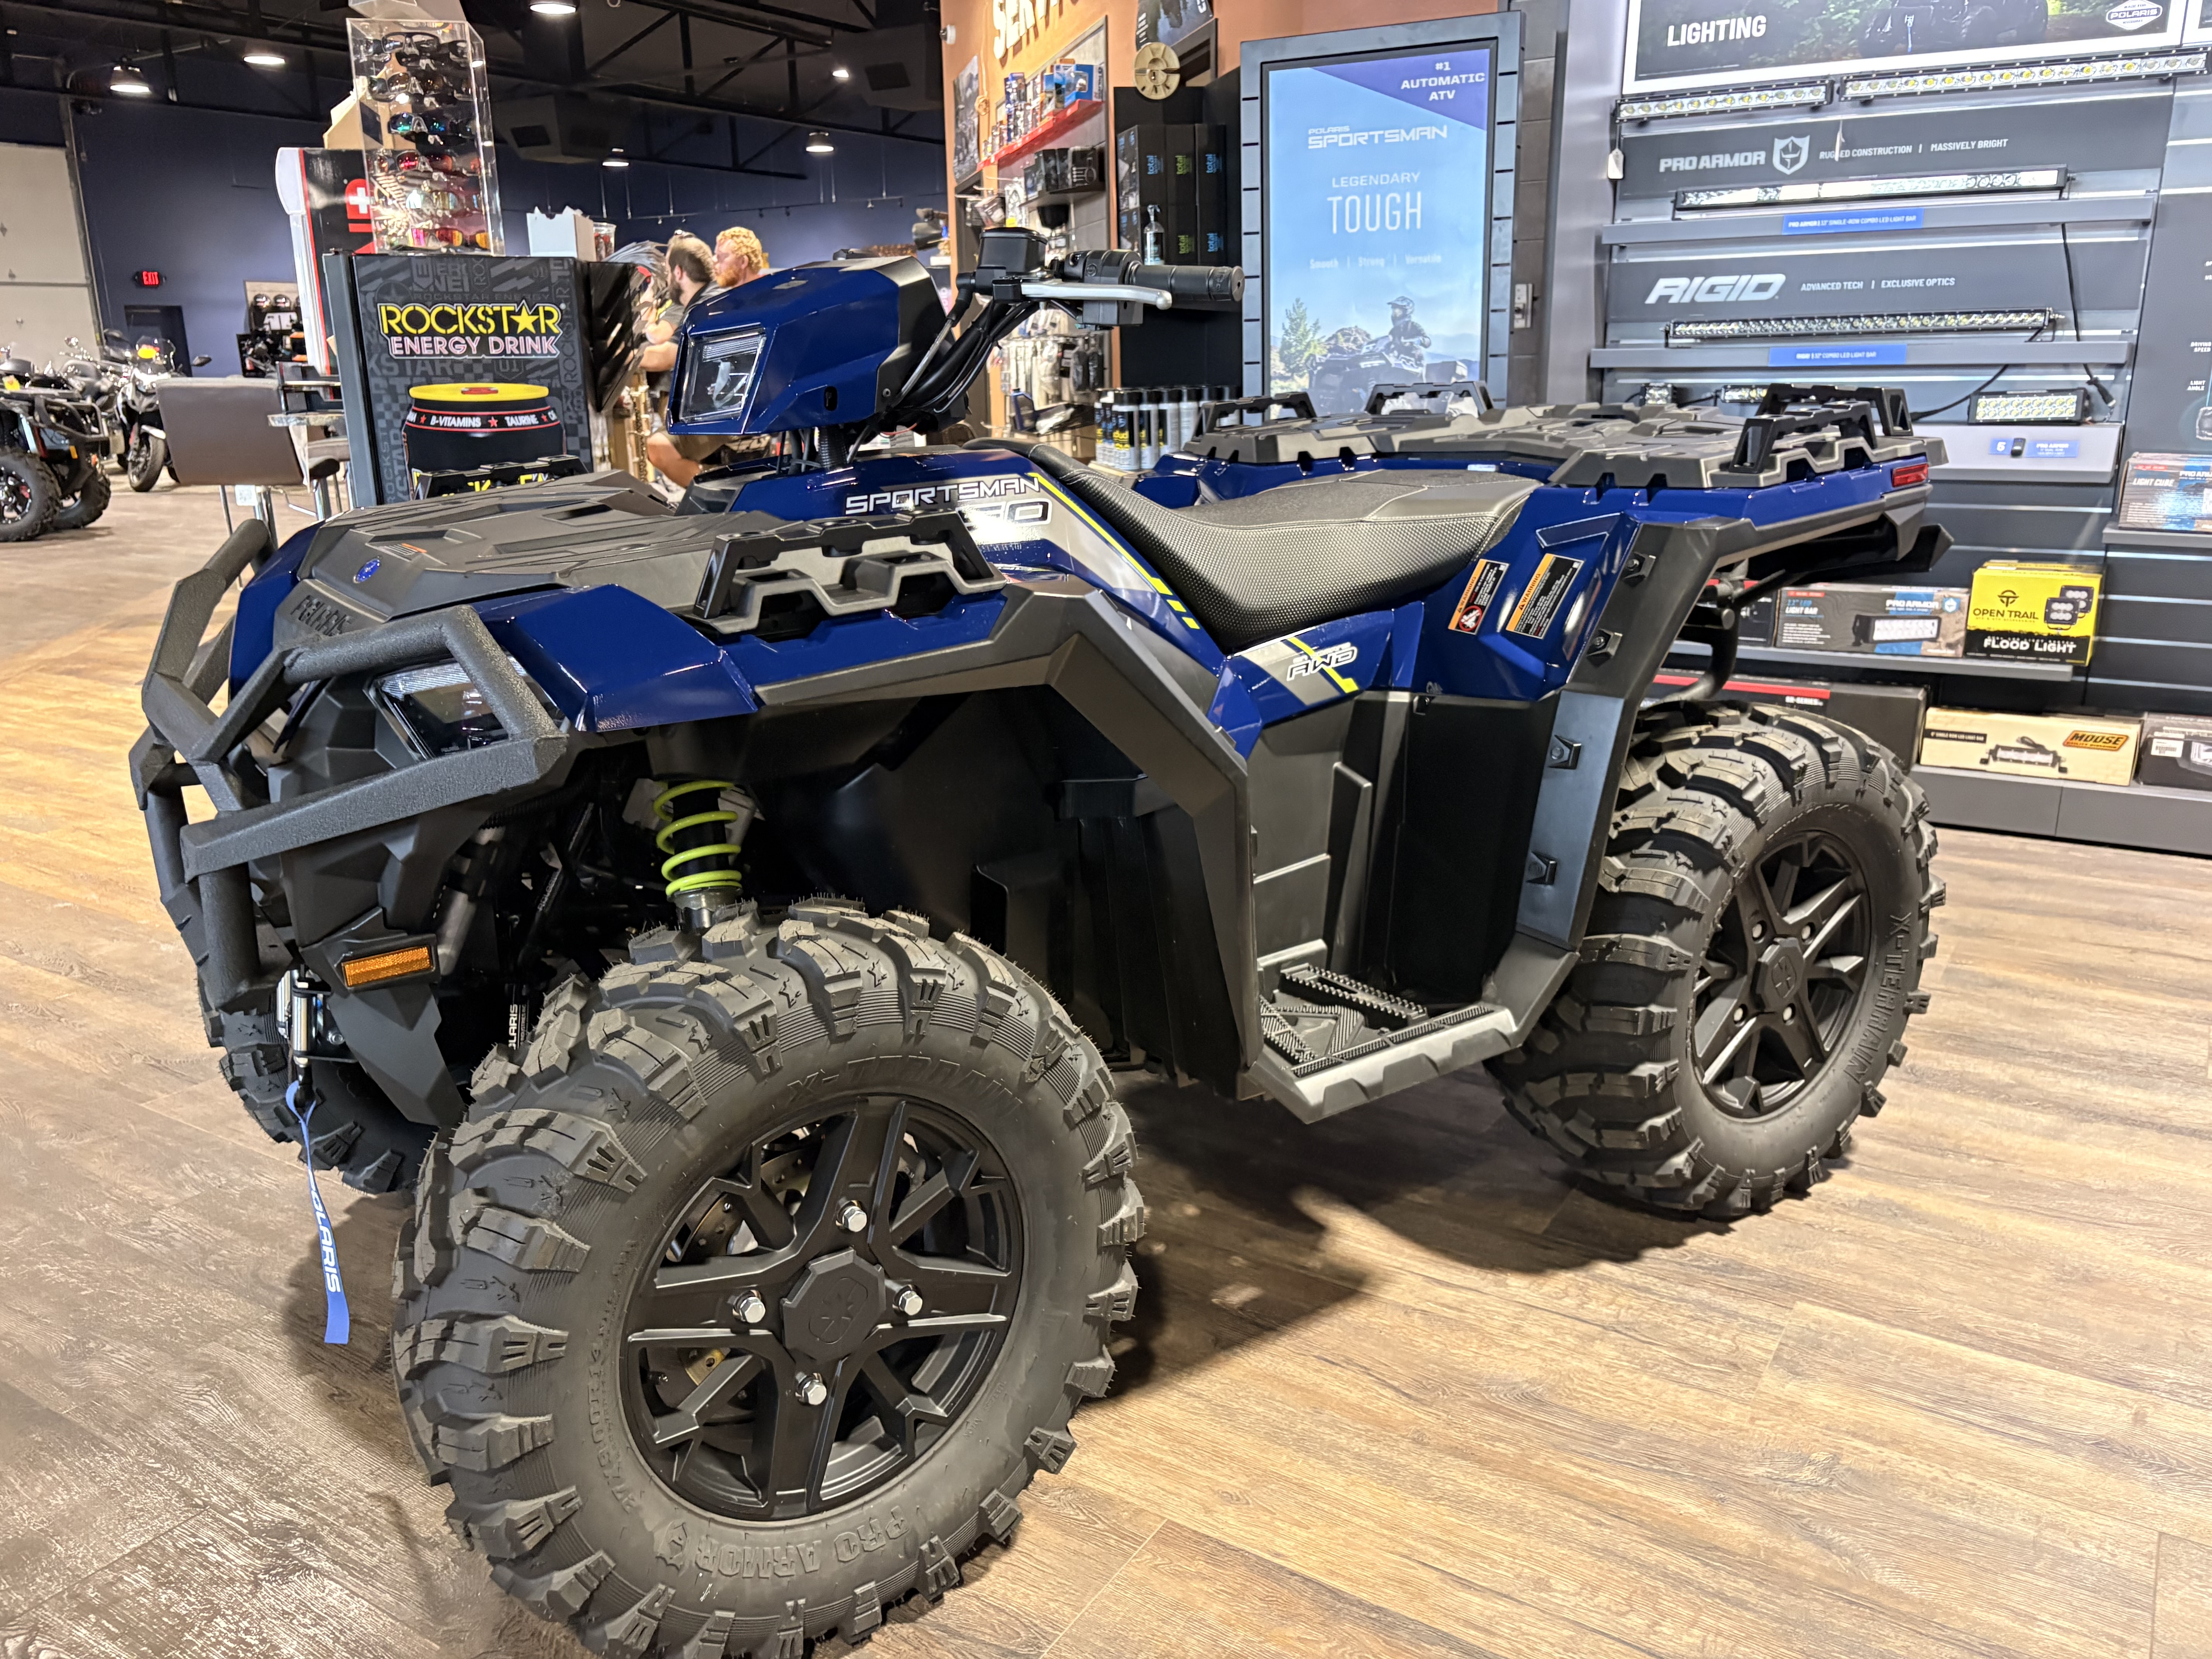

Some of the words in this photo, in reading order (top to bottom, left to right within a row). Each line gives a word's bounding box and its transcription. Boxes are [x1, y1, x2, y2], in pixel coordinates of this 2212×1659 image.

[2110, 9, 2158, 19] POLARIS
[1667, 15, 1767, 46] LIGHTING
[1435, 61, 1451, 71] #1
[1400, 72, 1486, 90] AUTOMATIC
[1428, 89, 1456, 101] ATV
[1307, 125, 1448, 149] SPORTSMAN
[1308, 125, 1350, 135] POLARIS
[1819, 149, 1851, 159] RUGED
[1851, 145, 1913, 158] CONSTRUCTION
[1930, 141, 1977, 152] MASSIVELY
[1977, 138, 2009, 149] BRIGHT
[1659, 156, 1698, 172] PRO
[1698, 150, 1766, 170] ARMOR
[1332, 172, 1421, 189] LEGENDARY
[1326, 192, 1422, 234] TOUGH
[1309, 258, 1339, 270] Smooth
[1358, 256, 1386, 268] Strong
[143, 271, 159, 285] EXIT
[1800, 282, 1841, 291] ADVANCED
[1843, 281, 1863, 289] TECH
[1881, 278, 1925, 289] EXCLUSIVE
[1926, 277, 1956, 287] OPTICS
[1644, 273, 1786, 304] RIGID
[380, 305, 561, 335] ROCKSTAR
[390, 336, 481, 355] ENERGY
[489, 336, 556, 354] DRINK
[430, 415, 481, 428] B-VITAMINS
[504, 414, 539, 426] TAURINE
[2154, 479, 2176, 487] CUBE
[845, 477, 1040, 515] SPORTSMAN
[1522, 573, 1541, 607] WARNING
[1886, 599, 1906, 608] PRO
[1906, 600, 1939, 609] ARMOR
[1973, 608, 2005, 618] OPEN
[2006, 610, 2039, 620] TRAIL
[1984, 637, 2030, 650] FLOOD
[2034, 641, 2077, 654] LIGHT
[1286, 646, 1358, 682] AWD
[2069, 733, 2124, 745] MOOSE
[308, 1169, 342, 1293] POLARIS
[834, 1505, 910, 1562] PRO
[695, 1535, 823, 1579] ARMOR
